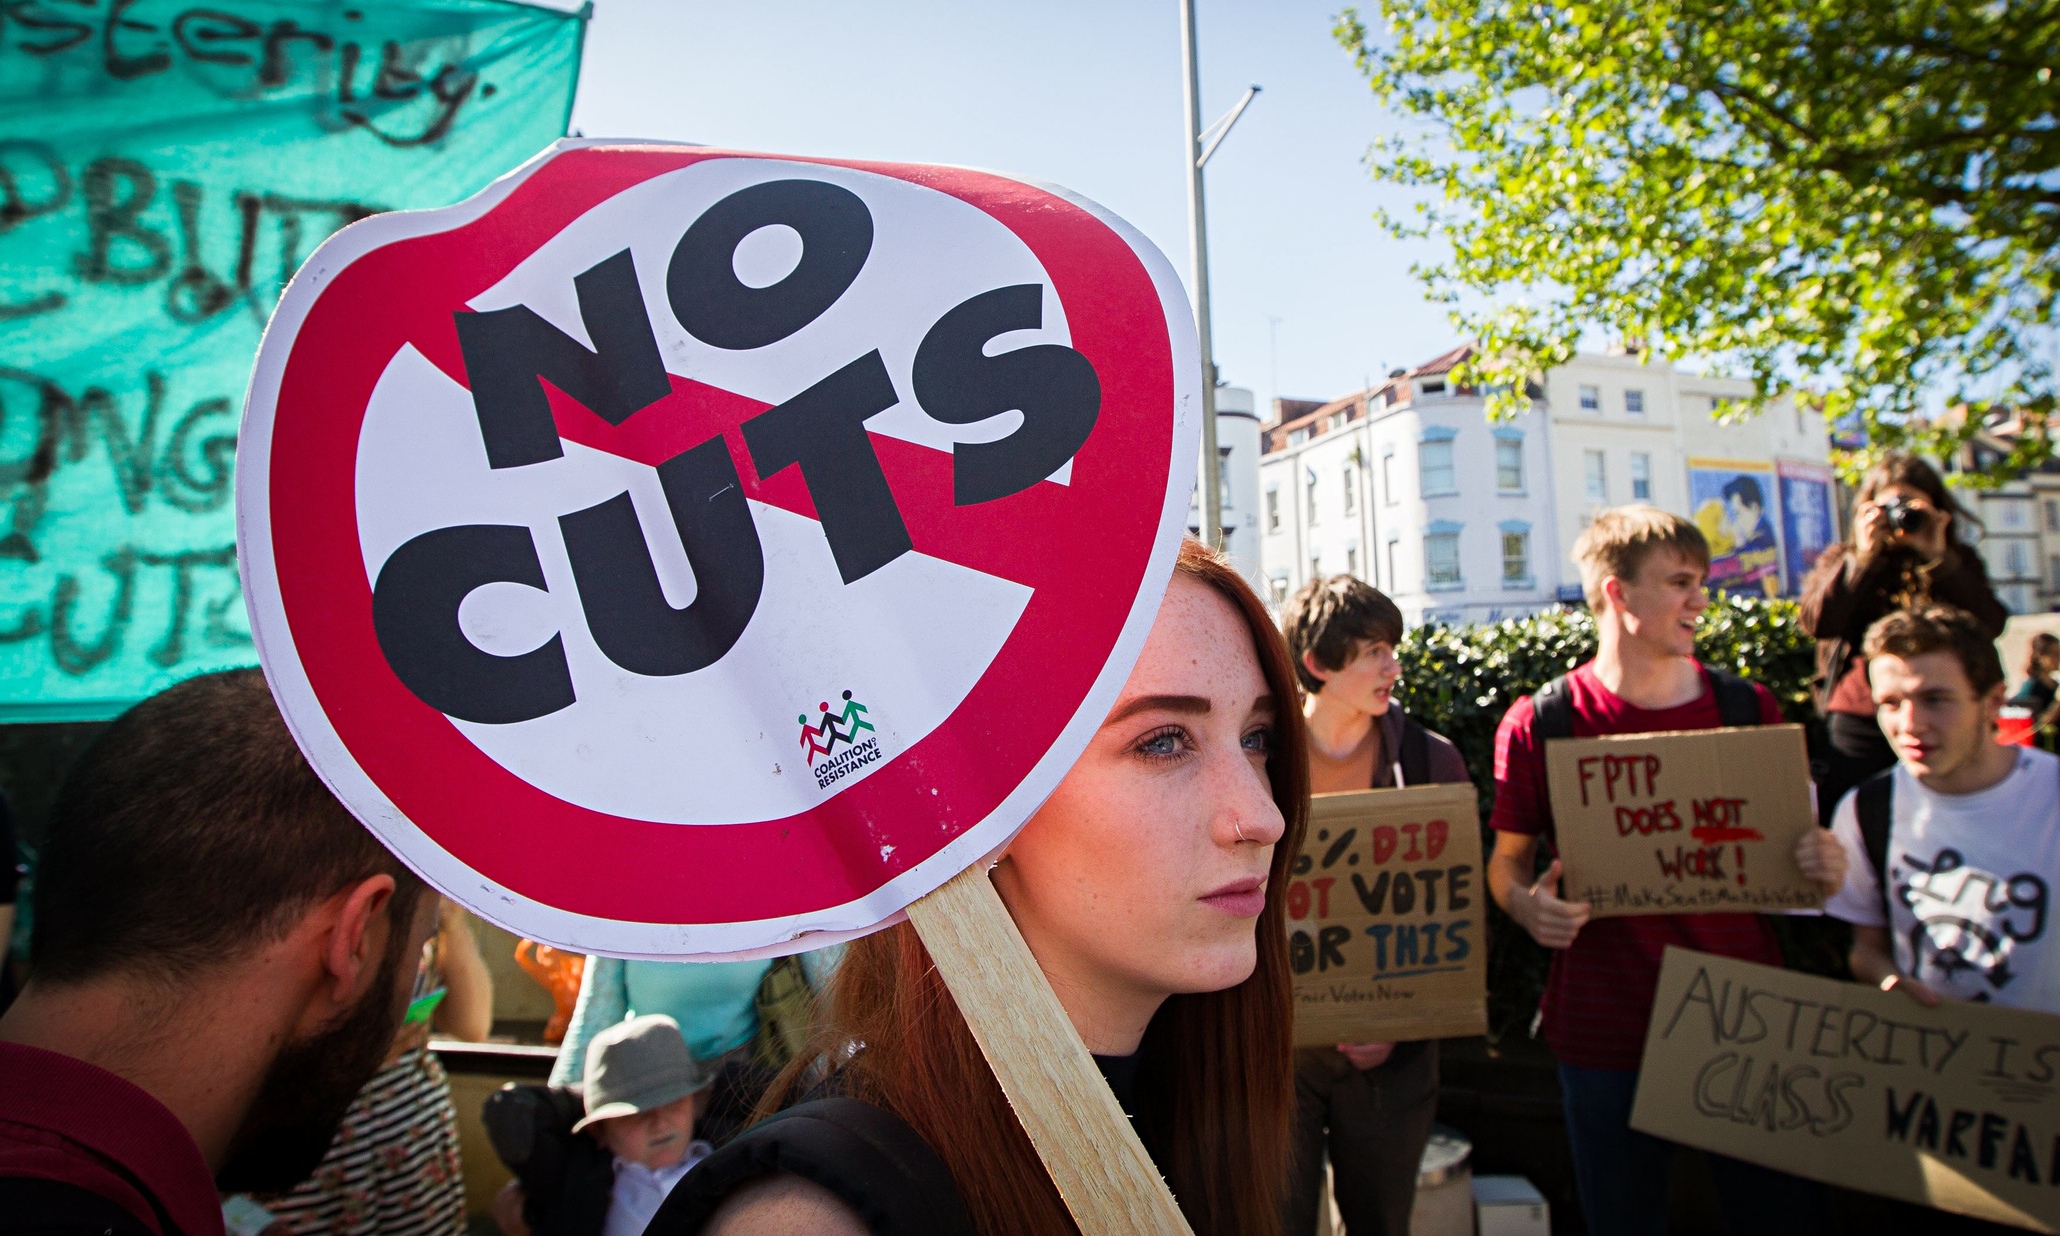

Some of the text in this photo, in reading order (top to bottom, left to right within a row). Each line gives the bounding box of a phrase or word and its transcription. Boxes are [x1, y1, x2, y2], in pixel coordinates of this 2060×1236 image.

[453, 179, 874, 469] NO
[372, 283, 1101, 725] CUTS
[814, 739, 873, 778] COALITION
[818, 748, 882, 790] RESISTANCE
[1578, 754, 1662, 807] FPTP
[1372, 820, 1450, 865] DID
[1615, 798, 1747, 837] DOES NOT
[1286, 865, 1474, 921] OT VOTE
[1289, 919, 1473, 975] OR THIS
[1661, 966, 2060, 1085] AUSTERITY IS
[1693, 1052, 2060, 1187] CLASS WARFA
